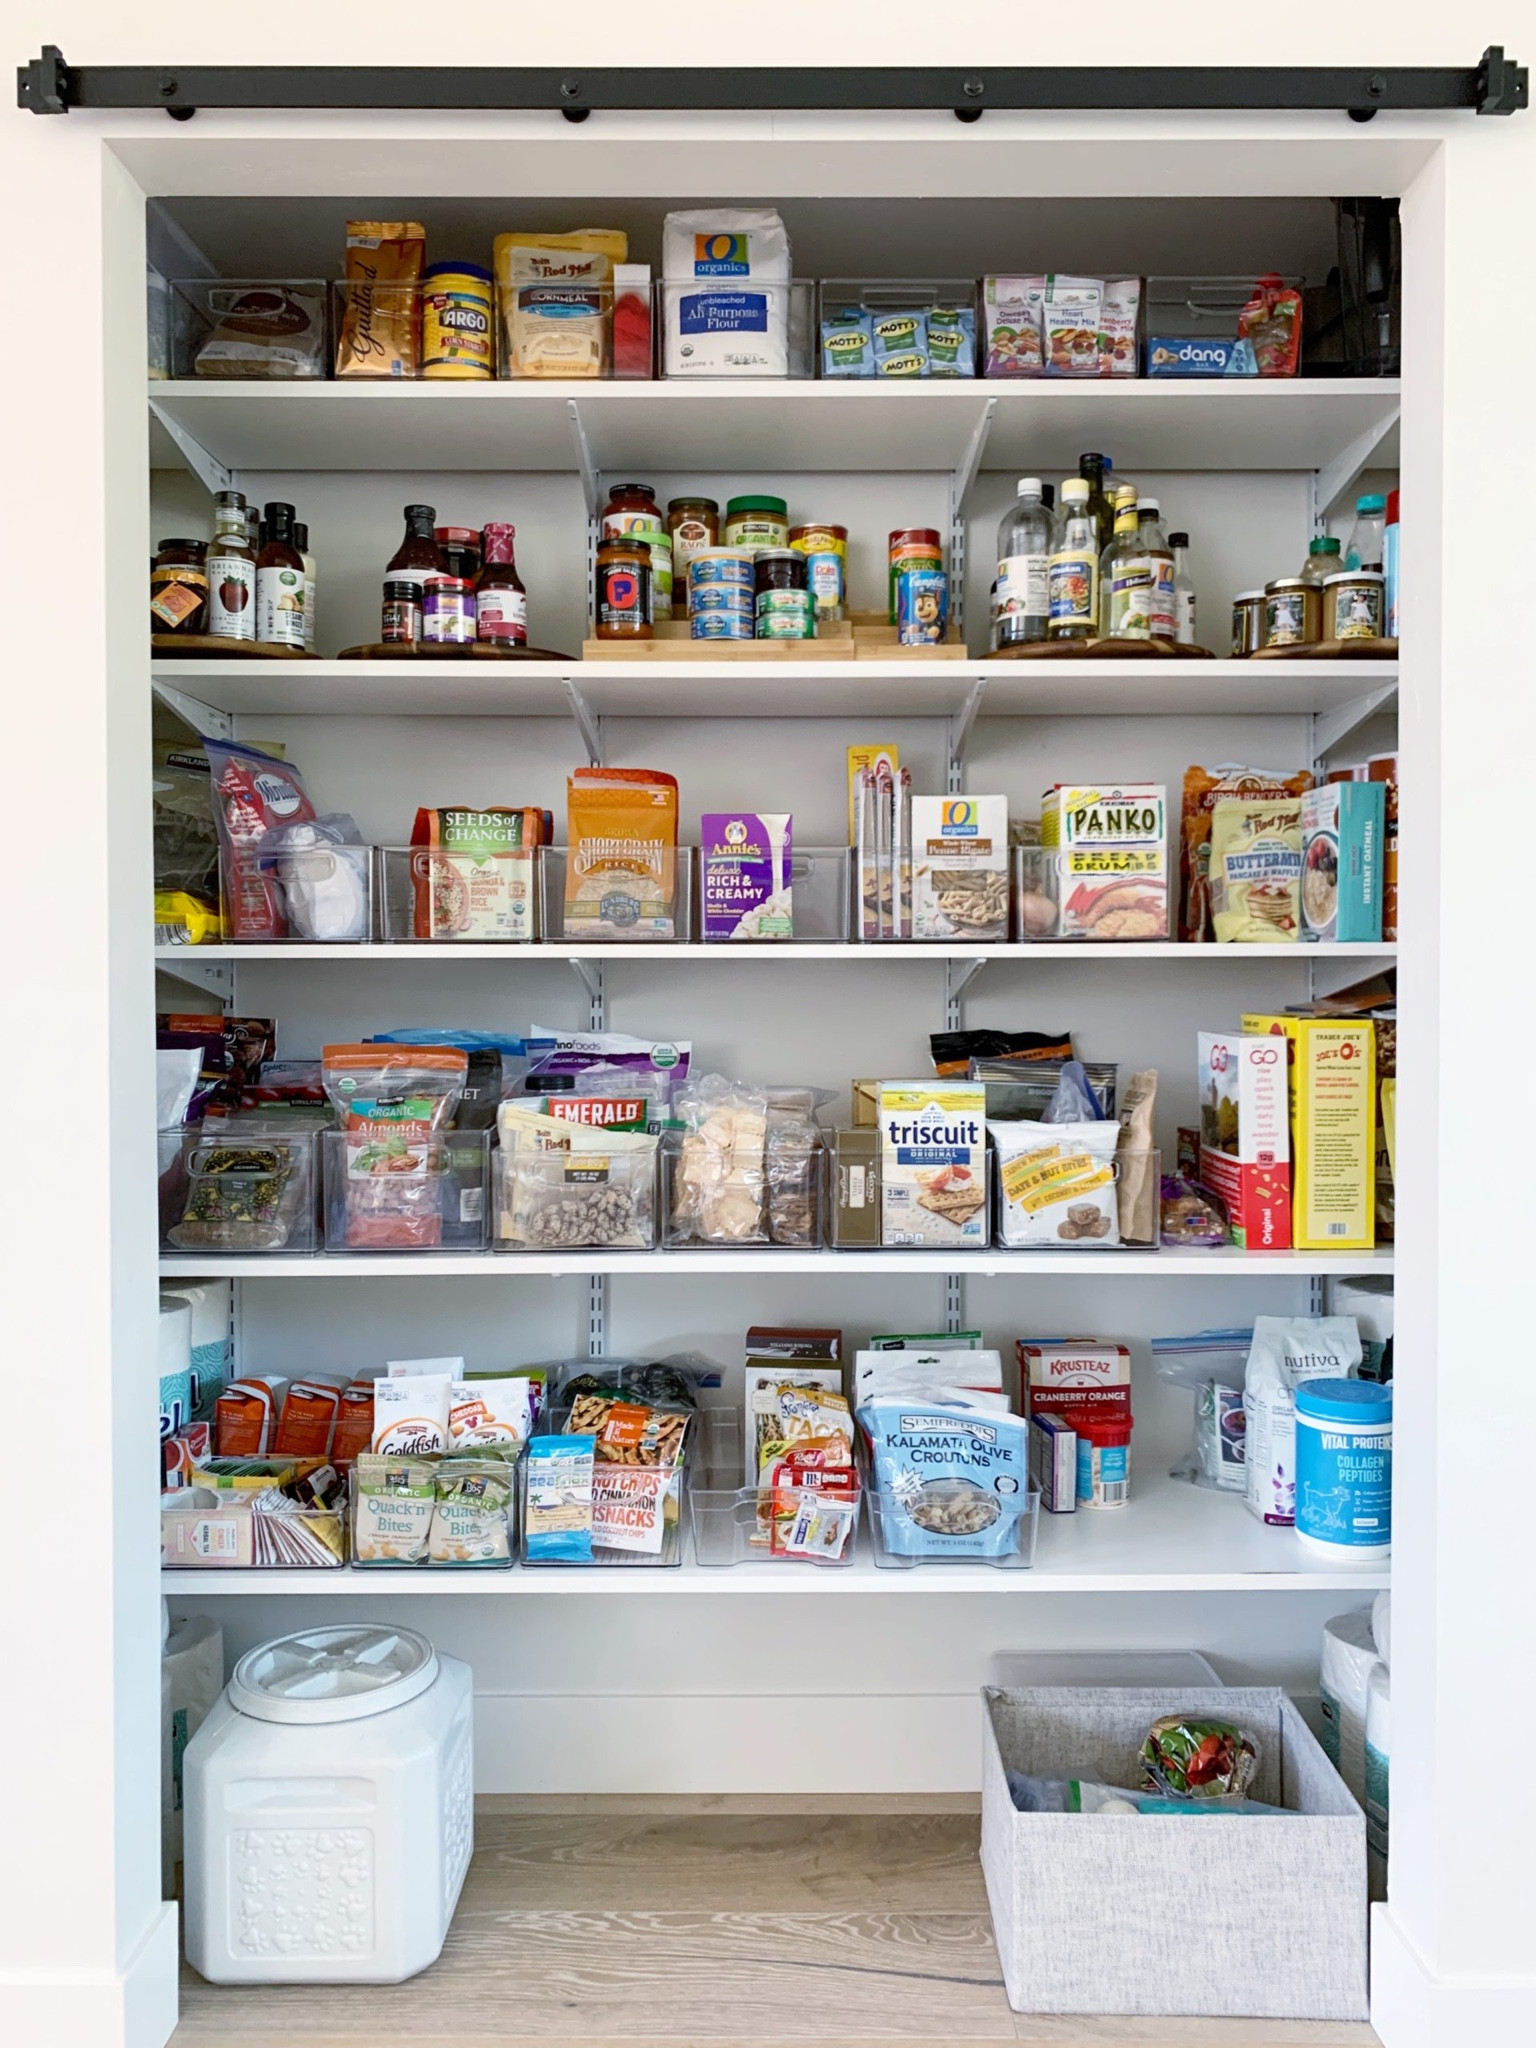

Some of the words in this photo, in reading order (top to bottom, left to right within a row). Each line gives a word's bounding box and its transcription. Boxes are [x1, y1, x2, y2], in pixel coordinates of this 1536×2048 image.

[543, 266, 567, 278] Red
[697, 263, 747, 274] organics
[530, 291, 589, 303] CORNMEAL
[700, 297, 746, 306] unbleached
[347, 261, 385, 363] Guittad
[444, 310, 486, 331] ARGO
[707, 318, 740, 330] Flour
[880, 321, 915, 335] MOTT'S
[1049, 319, 1079, 330] Healthy
[1179, 344, 1227, 367] dang
[886, 357, 922, 372] MOTT'S
[680, 541, 705, 551] RAO'S
[445, 812, 500, 827] SEEDS
[503, 814, 517, 827] of
[1074, 808, 1156, 835] PANKO
[1255, 816, 1275, 835] Red
[445, 828, 517, 842] CHANGE
[942, 826, 977, 836] organics
[1364, 820, 1373, 862] OATMEAL
[711, 843, 762, 856] Annie's
[706, 864, 741, 876] deluxe
[707, 875, 740, 887] RICH
[742, 875, 752, 887] &
[1363, 864, 1371, 904] INSTANT
[470, 887, 499, 897] BROWN
[706, 888, 764, 899] CREAMY
[470, 897, 489, 907] RICE
[1210, 1044, 1229, 1073] GO
[1249, 1049, 1279, 1066] GO
[1315, 1048, 1339, 1063] JOE'S
[367, 1106, 415, 1118] ORGANIC
[554, 1102, 640, 1125] EMERALD
[358, 1120, 423, 1137] Almonds
[888, 1120, 979, 1145] triscuit
[545, 1138, 563, 1151] Red
[1259, 1152, 1274, 1162] 12g
[1007, 1178, 1032, 1198] DATE
[1040, 1165, 1061, 1182] NUT
[1261, 1208, 1274, 1246] Original
[1050, 1359, 1111, 1376] KRUSTEAZ
[1284, 1352, 1341, 1368] nutiva
[1033, 1393, 1086, 1402] CRANBERRY
[1087, 1391, 1126, 1401] ORANGE
[451, 1406, 483, 1422] CHEDDAR
[382, 1433, 441, 1456] Goldfish
[611, 1435, 637, 1446] Nature
[887, 1434, 967, 1450] KALAMATA
[970, 1439, 1013, 1462] OLIVE
[1321, 1432, 1350, 1450] VITAL
[910, 1449, 991, 1468] CROUTONS
[1336, 1454, 1385, 1470] COLLAGEN
[1338, 1469, 1383, 1483] PEPTIDES
[367, 1500, 411, 1519] Quack
[377, 1517, 414, 1533] Bites
